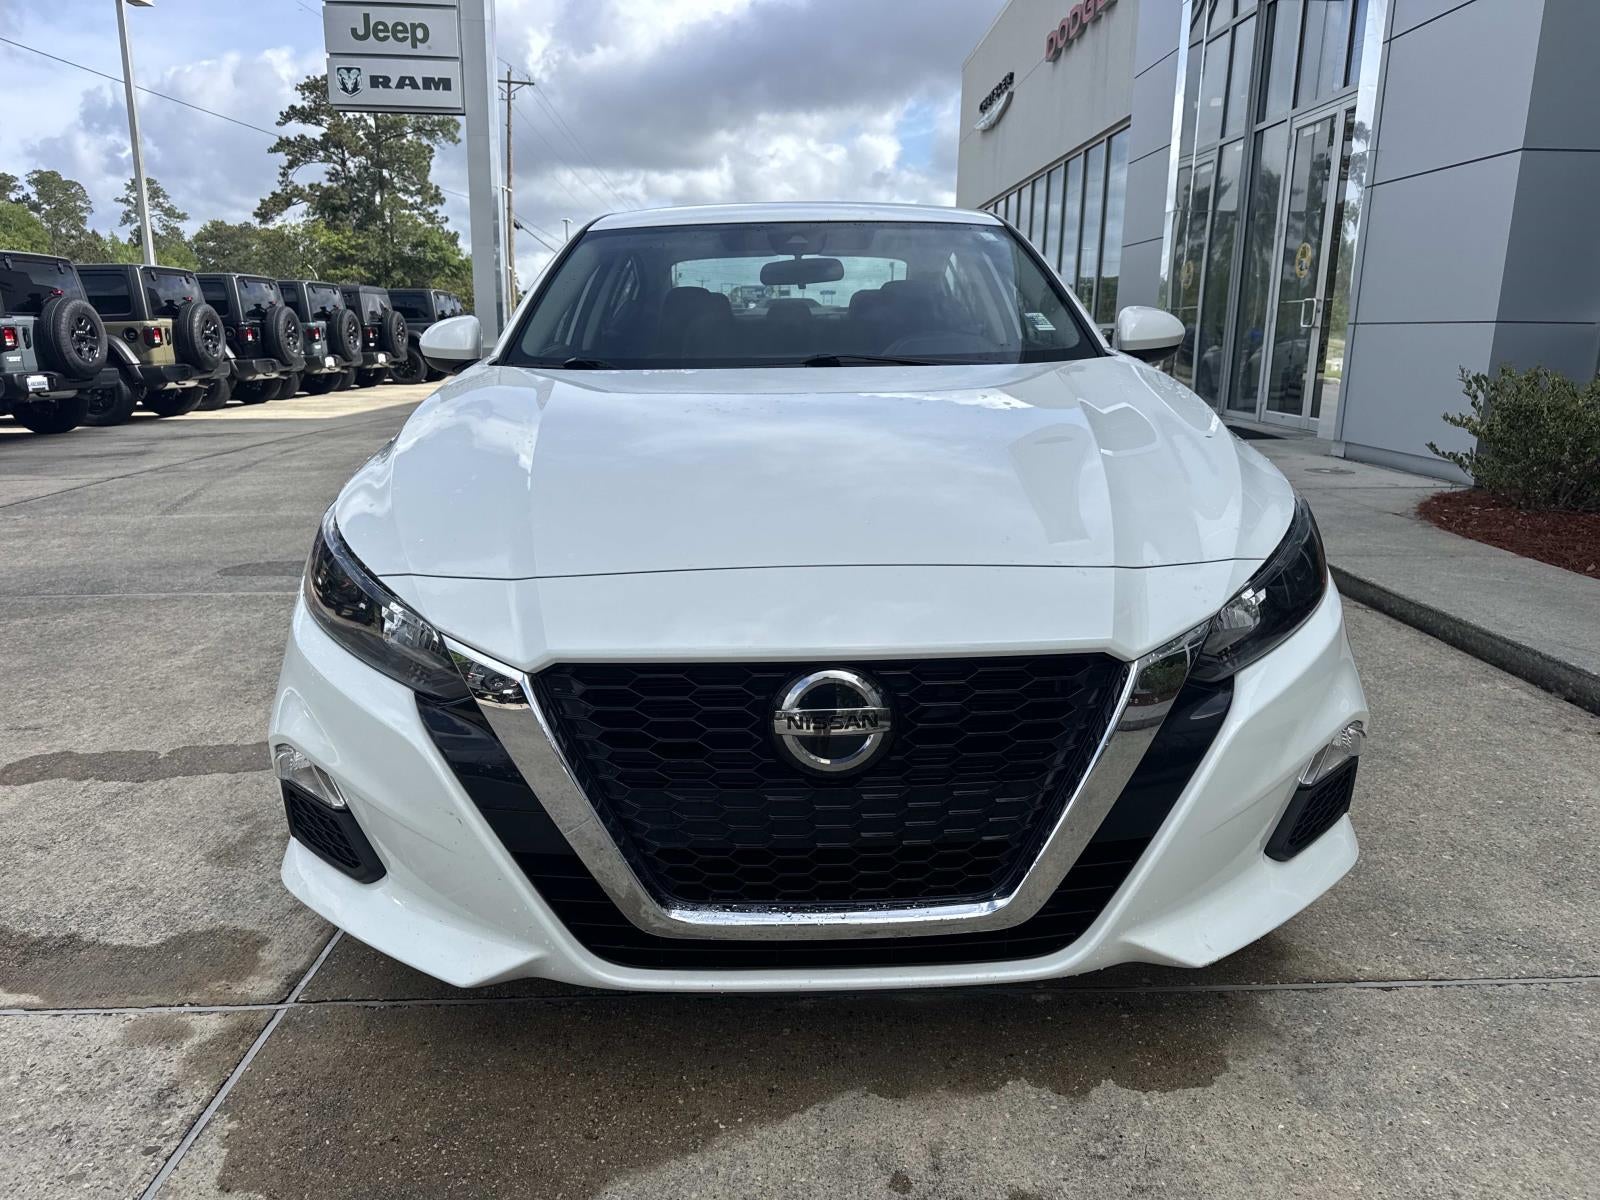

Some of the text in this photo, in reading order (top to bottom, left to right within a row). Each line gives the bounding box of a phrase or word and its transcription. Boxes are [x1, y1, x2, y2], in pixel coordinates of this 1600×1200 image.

[350, 13, 430, 49] Jeep
[369, 75, 452, 92] RAM
[786, 714, 879, 730] NISSAN
